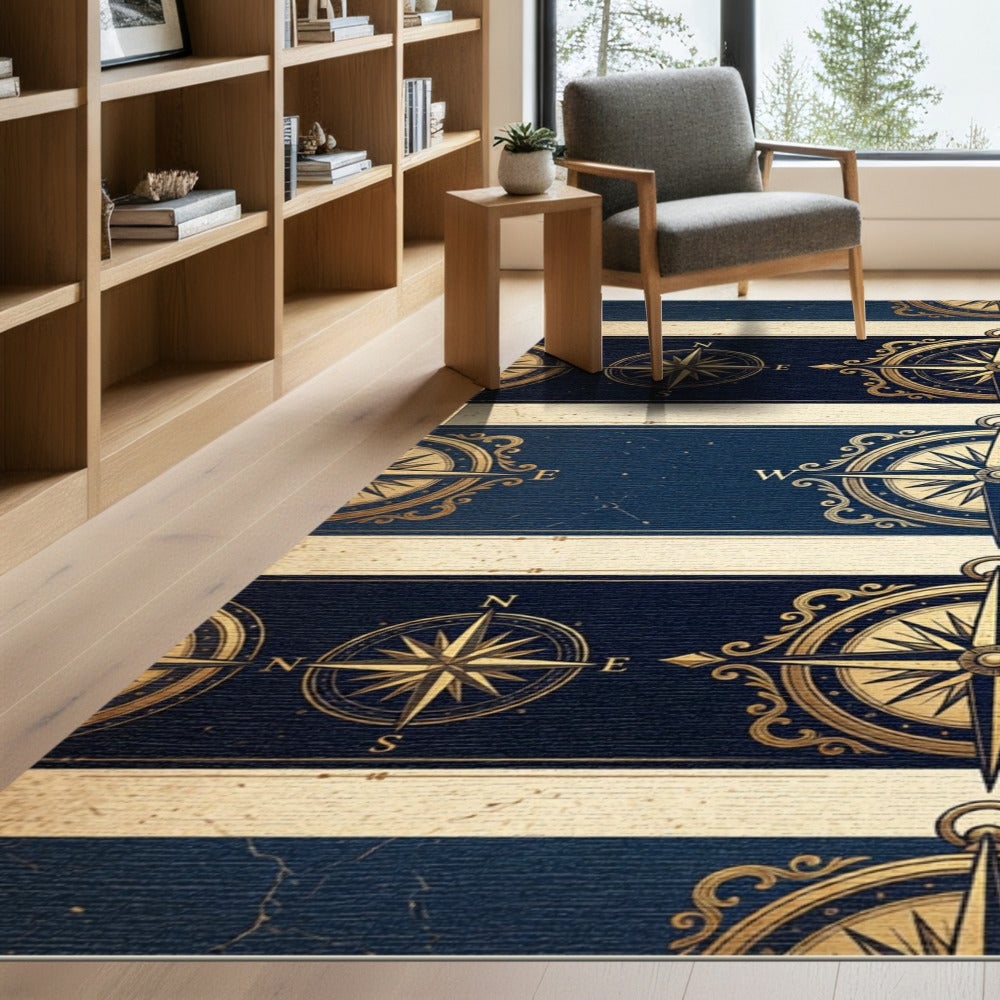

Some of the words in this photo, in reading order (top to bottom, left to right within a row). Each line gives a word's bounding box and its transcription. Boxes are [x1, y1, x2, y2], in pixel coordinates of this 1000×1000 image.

[775, 363, 790, 371] E
[529, 469, 560, 481] E
[754, 469, 799, 481] W
[481, 594, 518, 608] N
[261, 657, 306, 672] N
[601, 657, 631, 672] E
[369, 734, 402, 753] S
